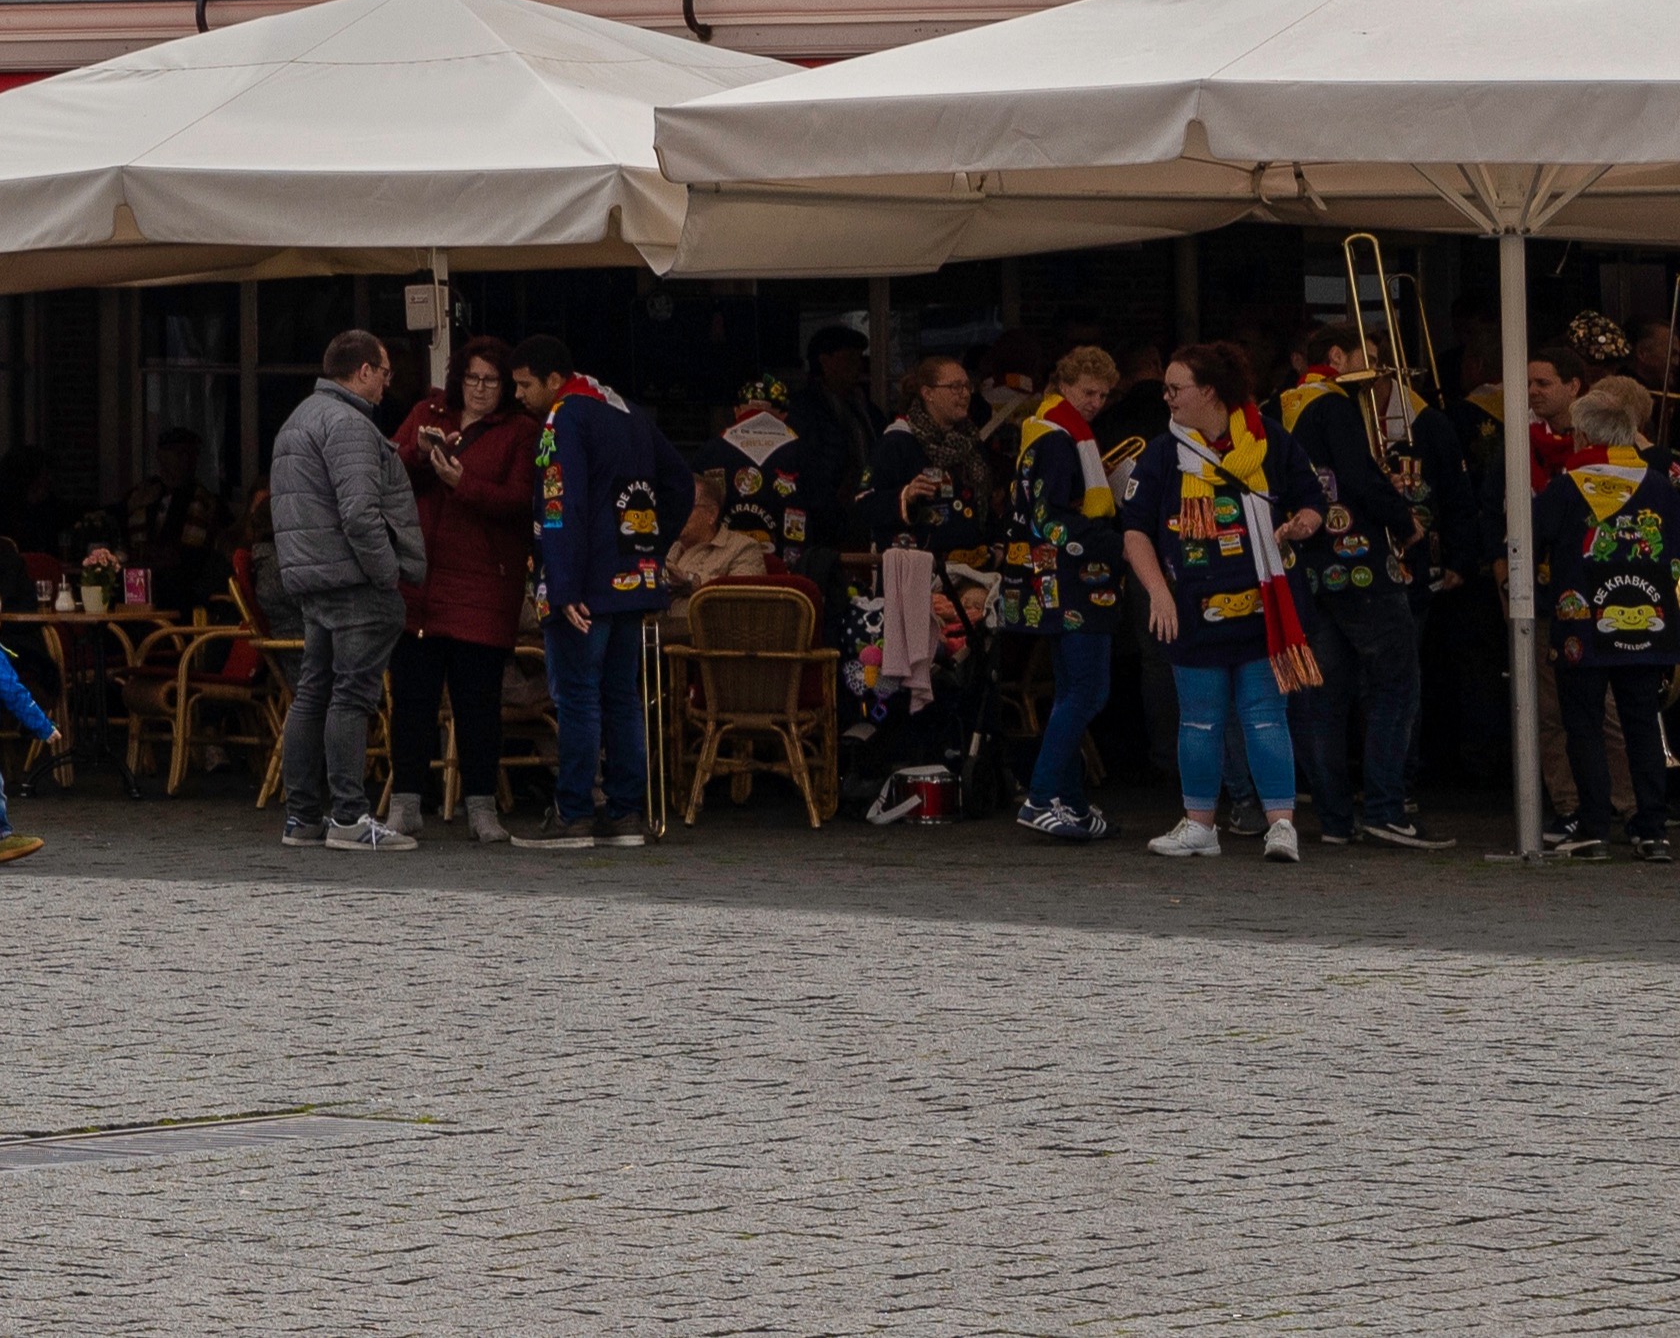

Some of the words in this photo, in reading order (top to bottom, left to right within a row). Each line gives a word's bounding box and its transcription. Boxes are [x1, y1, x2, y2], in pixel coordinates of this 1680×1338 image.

[616, 490, 631, 510] DE
[1593, 587, 1609, 605] DE
[1604, 574, 1661, 603] KRABKES
